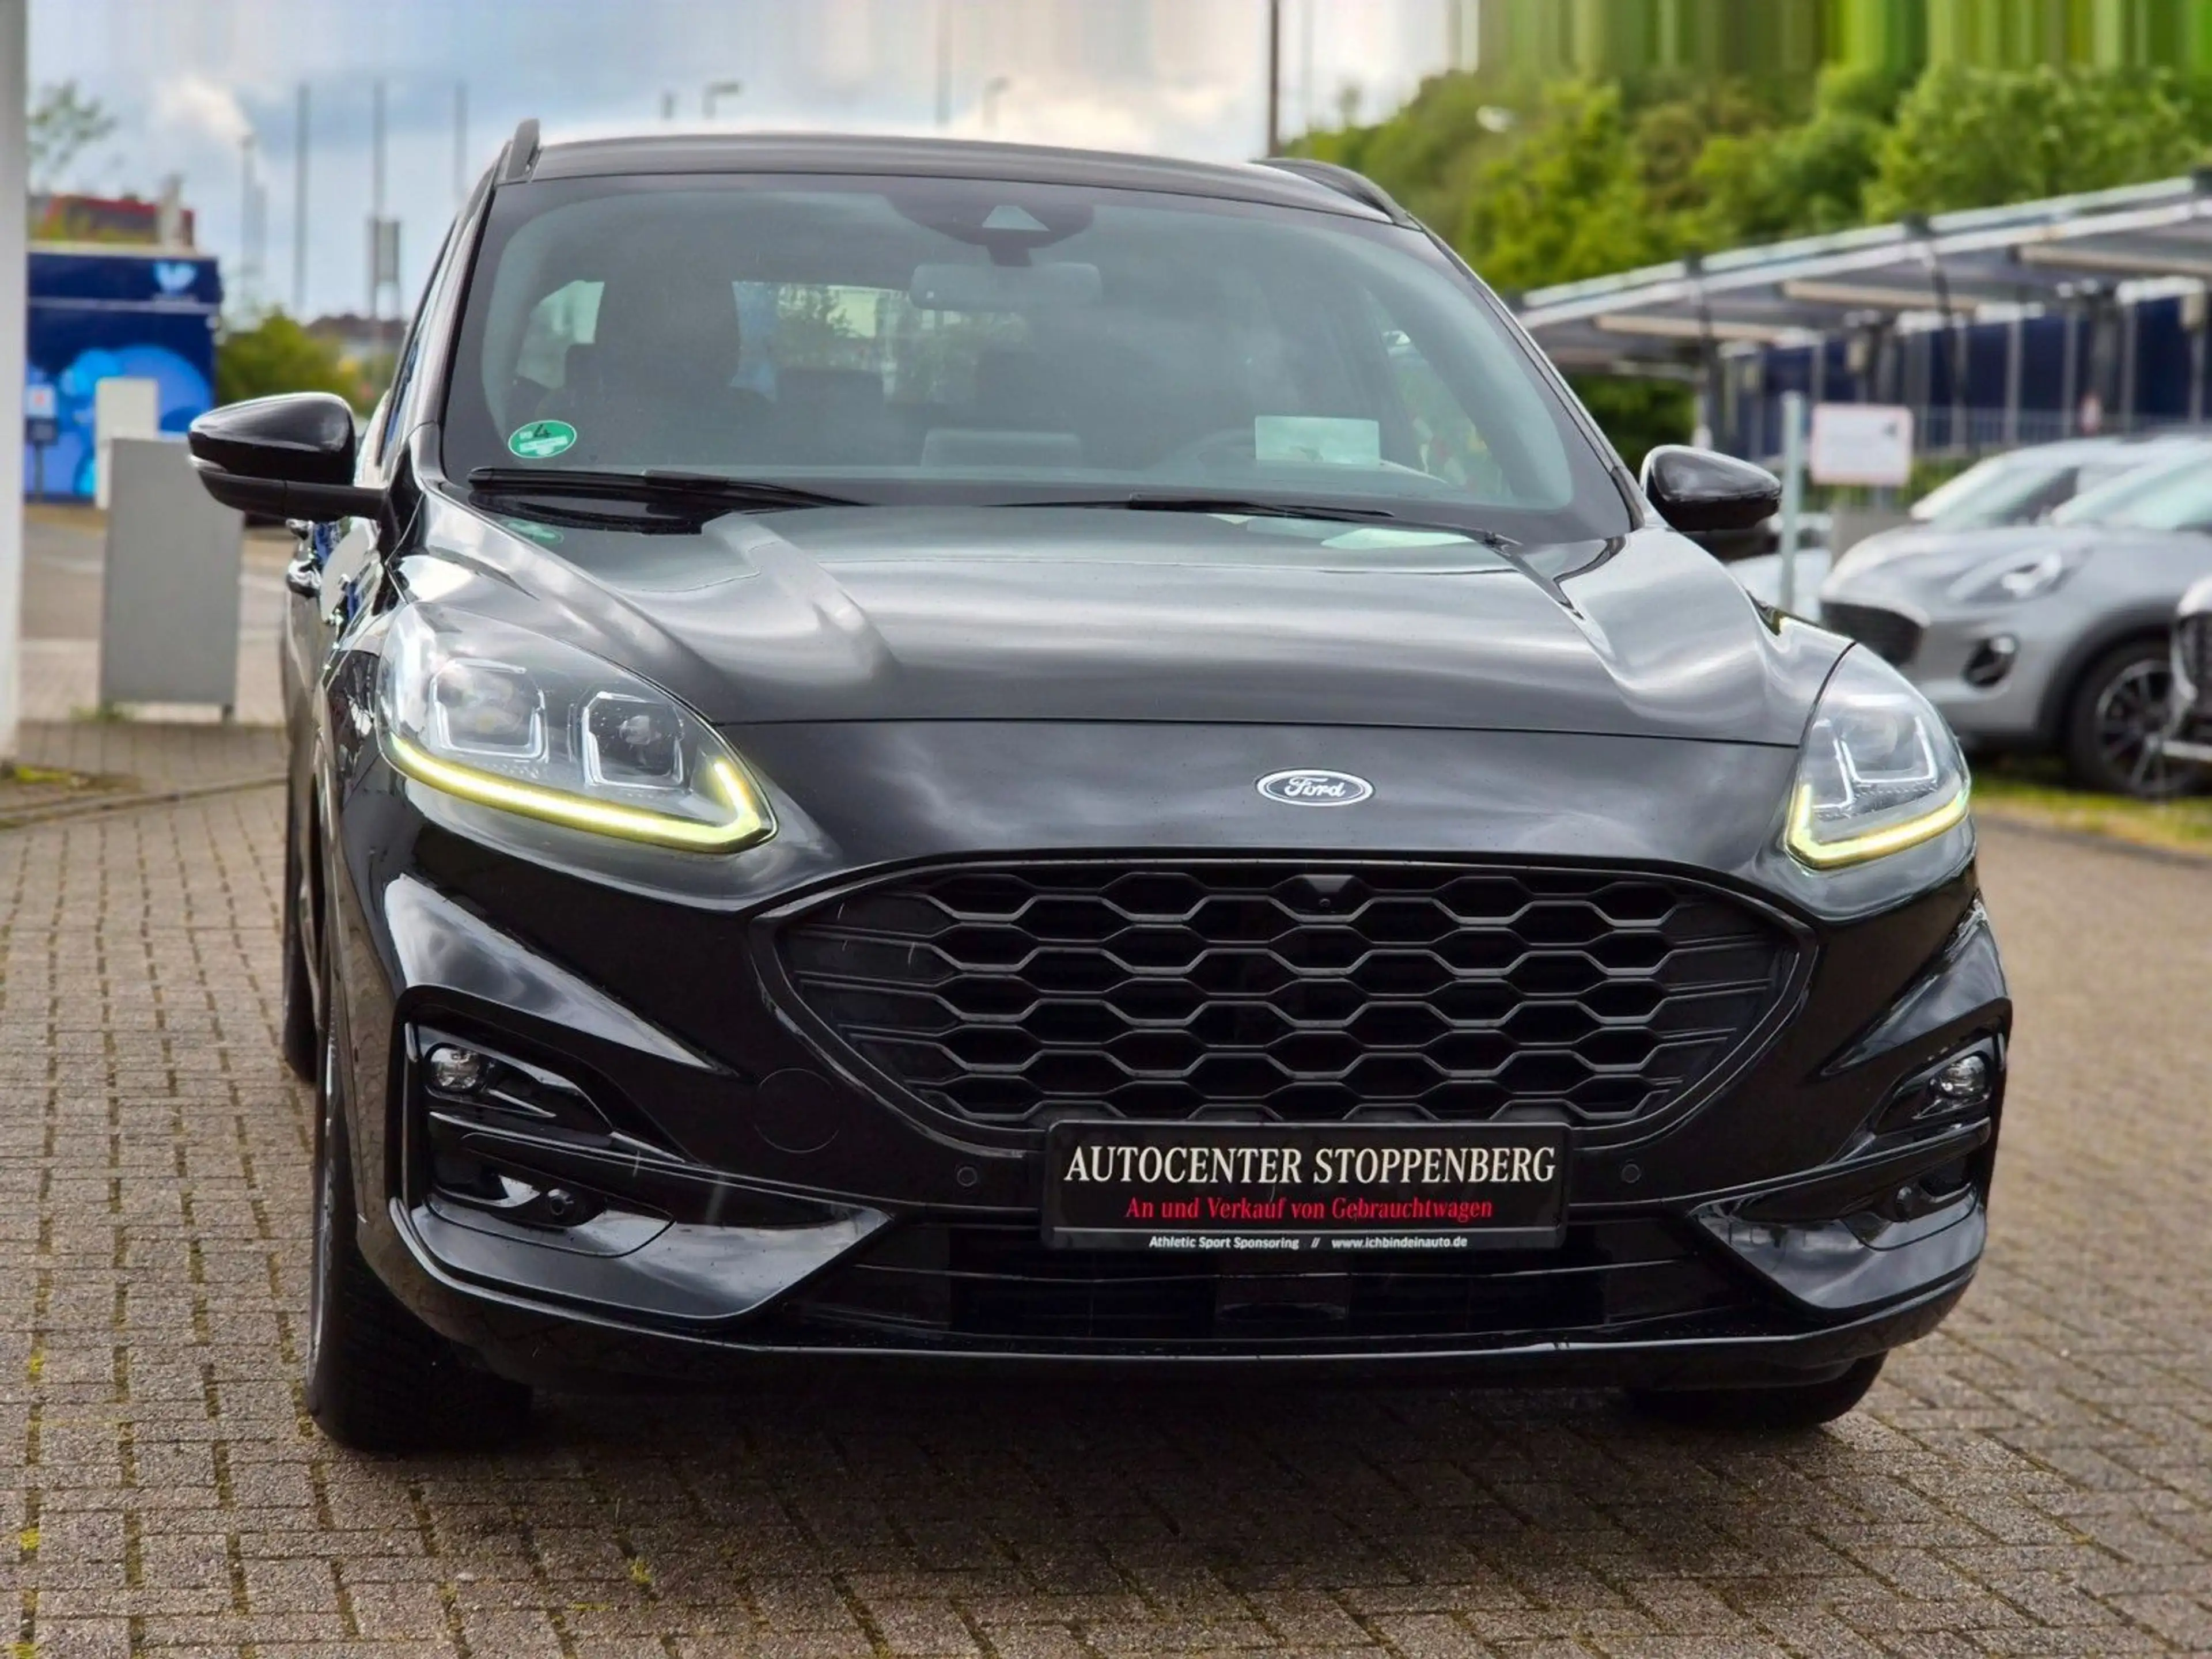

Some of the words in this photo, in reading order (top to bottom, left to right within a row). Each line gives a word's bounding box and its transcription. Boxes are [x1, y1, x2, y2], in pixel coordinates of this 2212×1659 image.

[1284, 777, 1347, 797] Ford
[1063, 1145, 1302, 1184] AUTOCENTER
[1313, 1146, 1556, 1184] STOPPENBERG
[1125, 1196, 1153, 1219] An
[1161, 1197, 1199, 1219] und
[1207, 1196, 1286, 1219] Verkauf
[1290, 1202, 1324, 1219] von
[1332, 1196, 1493, 1222] Gebrauchtwagen
[1149, 1236, 1196, 1248] Athletic
[1198, 1236, 1231, 1249] Sport
[1233, 1237, 1300, 1251] Sponsoring
[1331, 1236, 1468, 1249] www.ichbindeinauto.de
